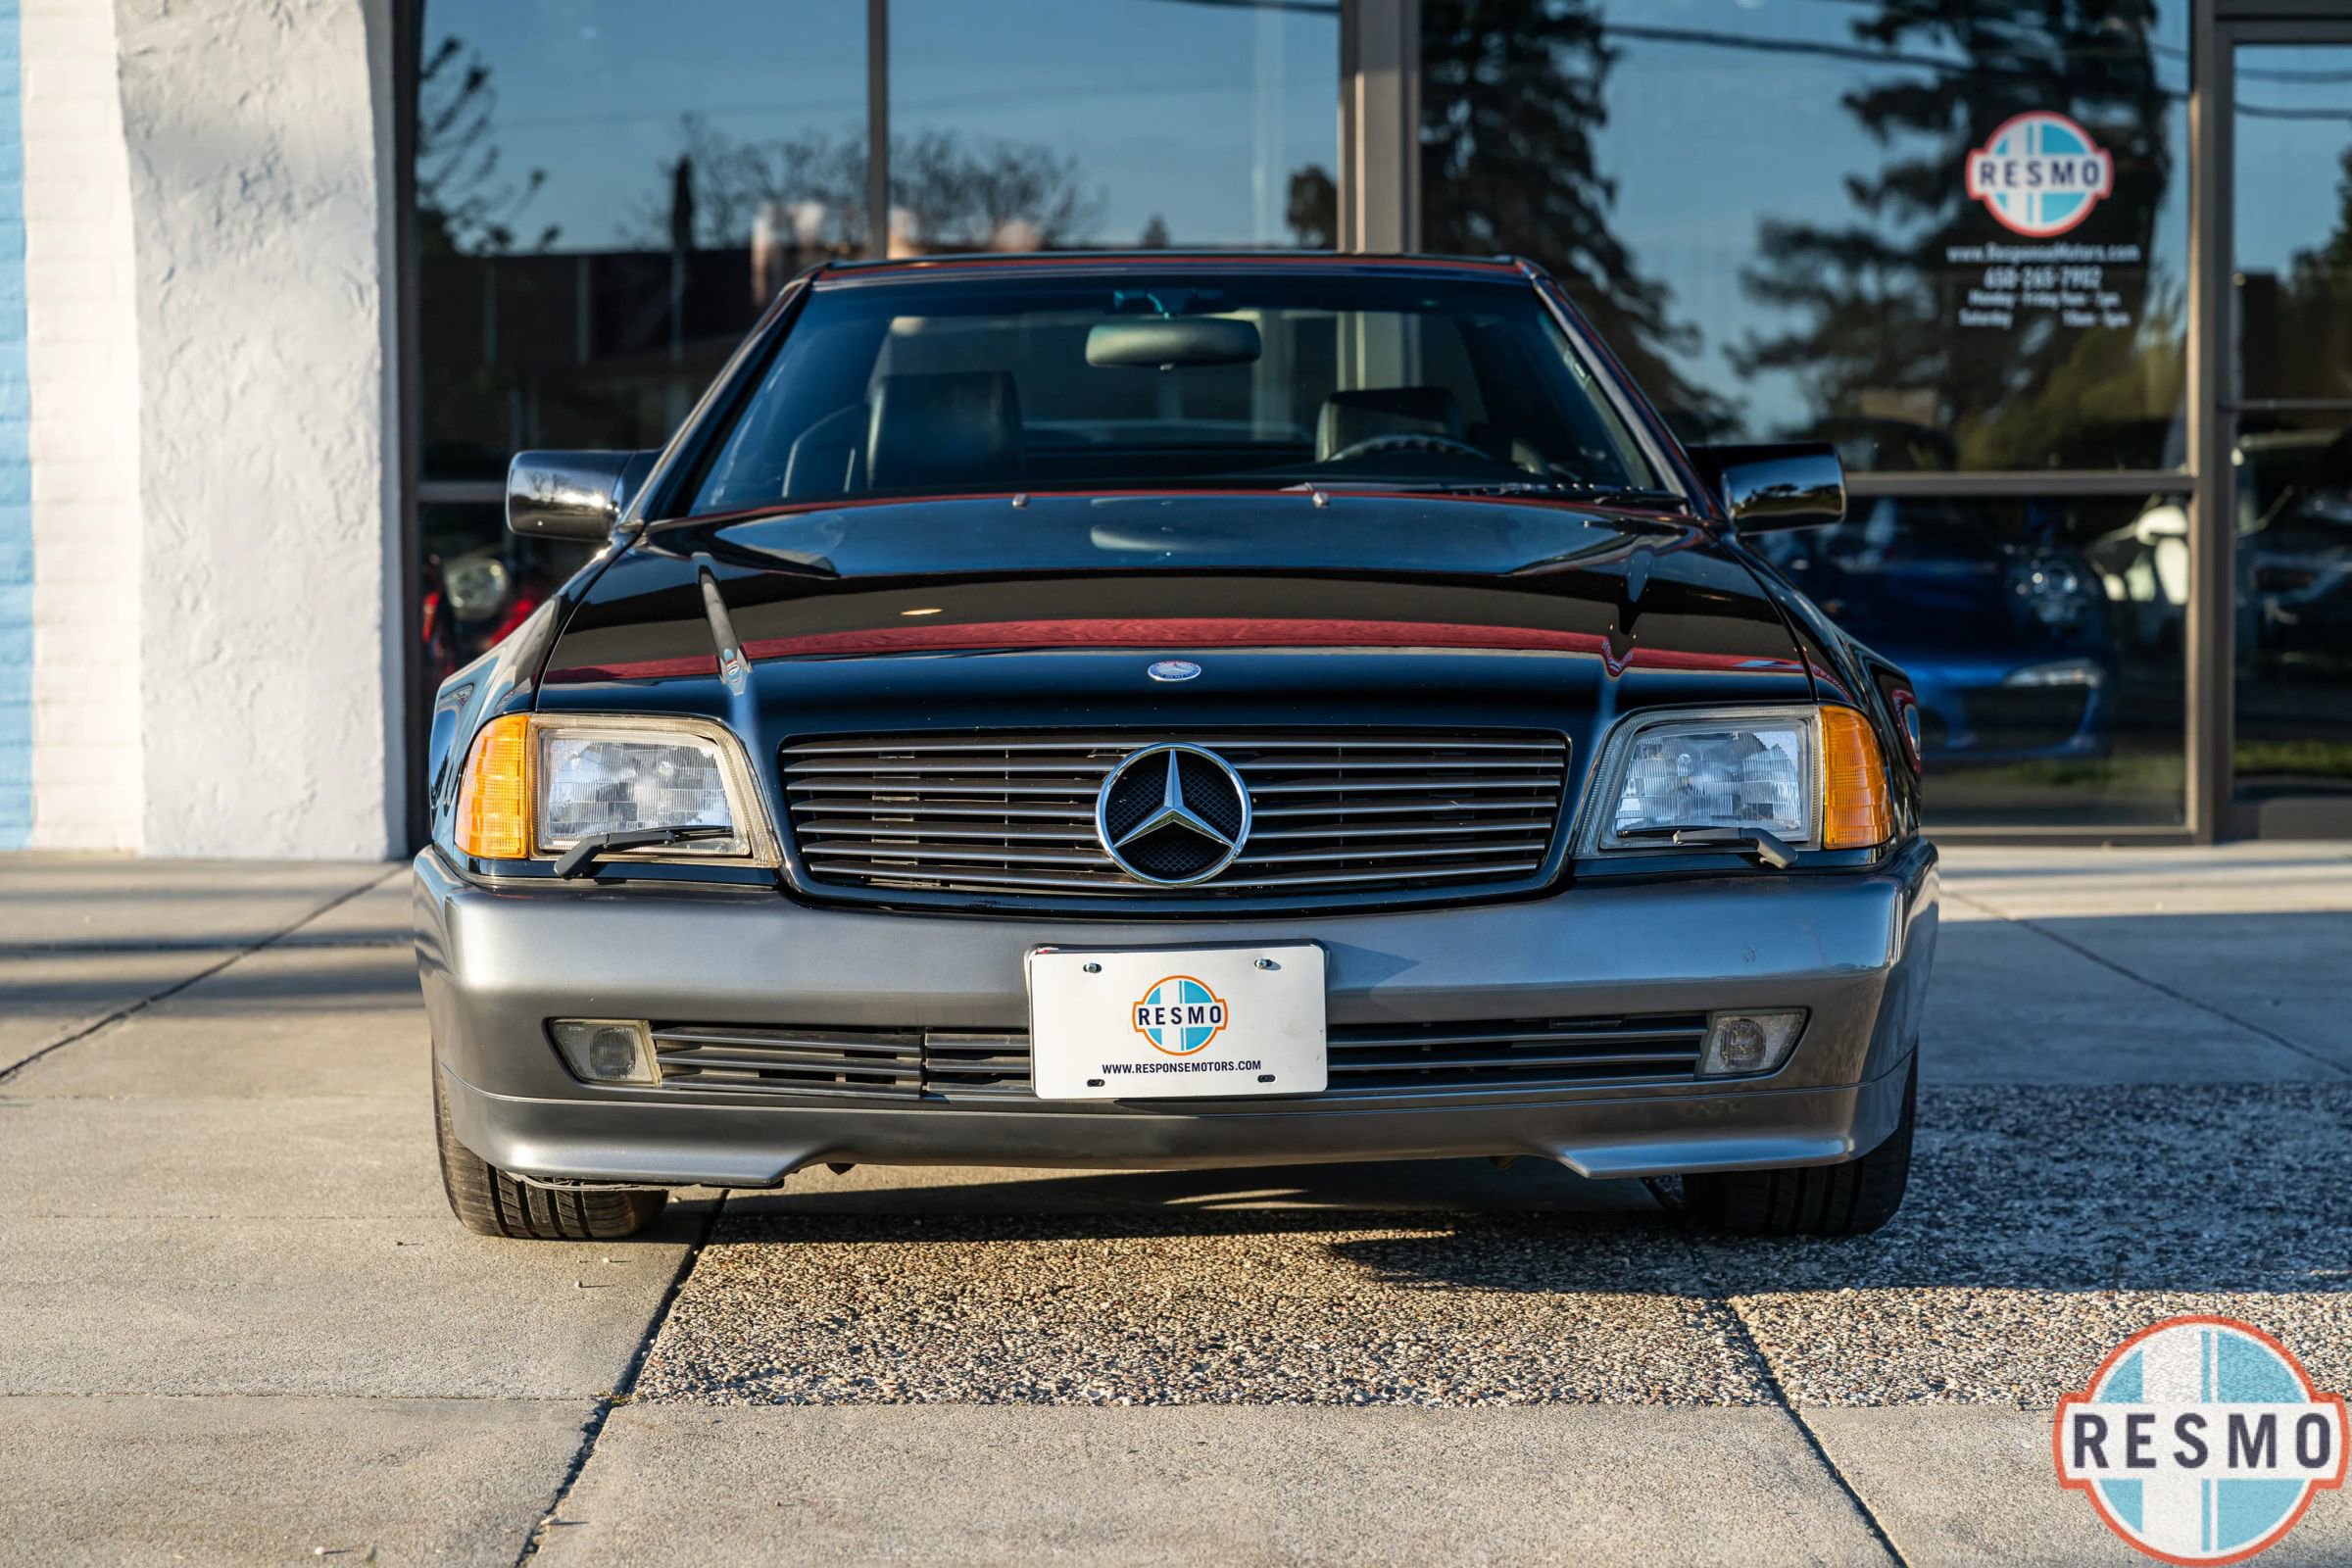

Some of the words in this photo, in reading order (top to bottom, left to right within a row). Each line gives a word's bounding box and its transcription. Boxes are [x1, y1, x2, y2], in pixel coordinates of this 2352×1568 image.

[1980, 160, 2099, 187] RESMO
[1138, 1005, 1222, 1026] RESMO
[1102, 1059, 1262, 1074] WWW.RESPONSEMOTORS.COM
